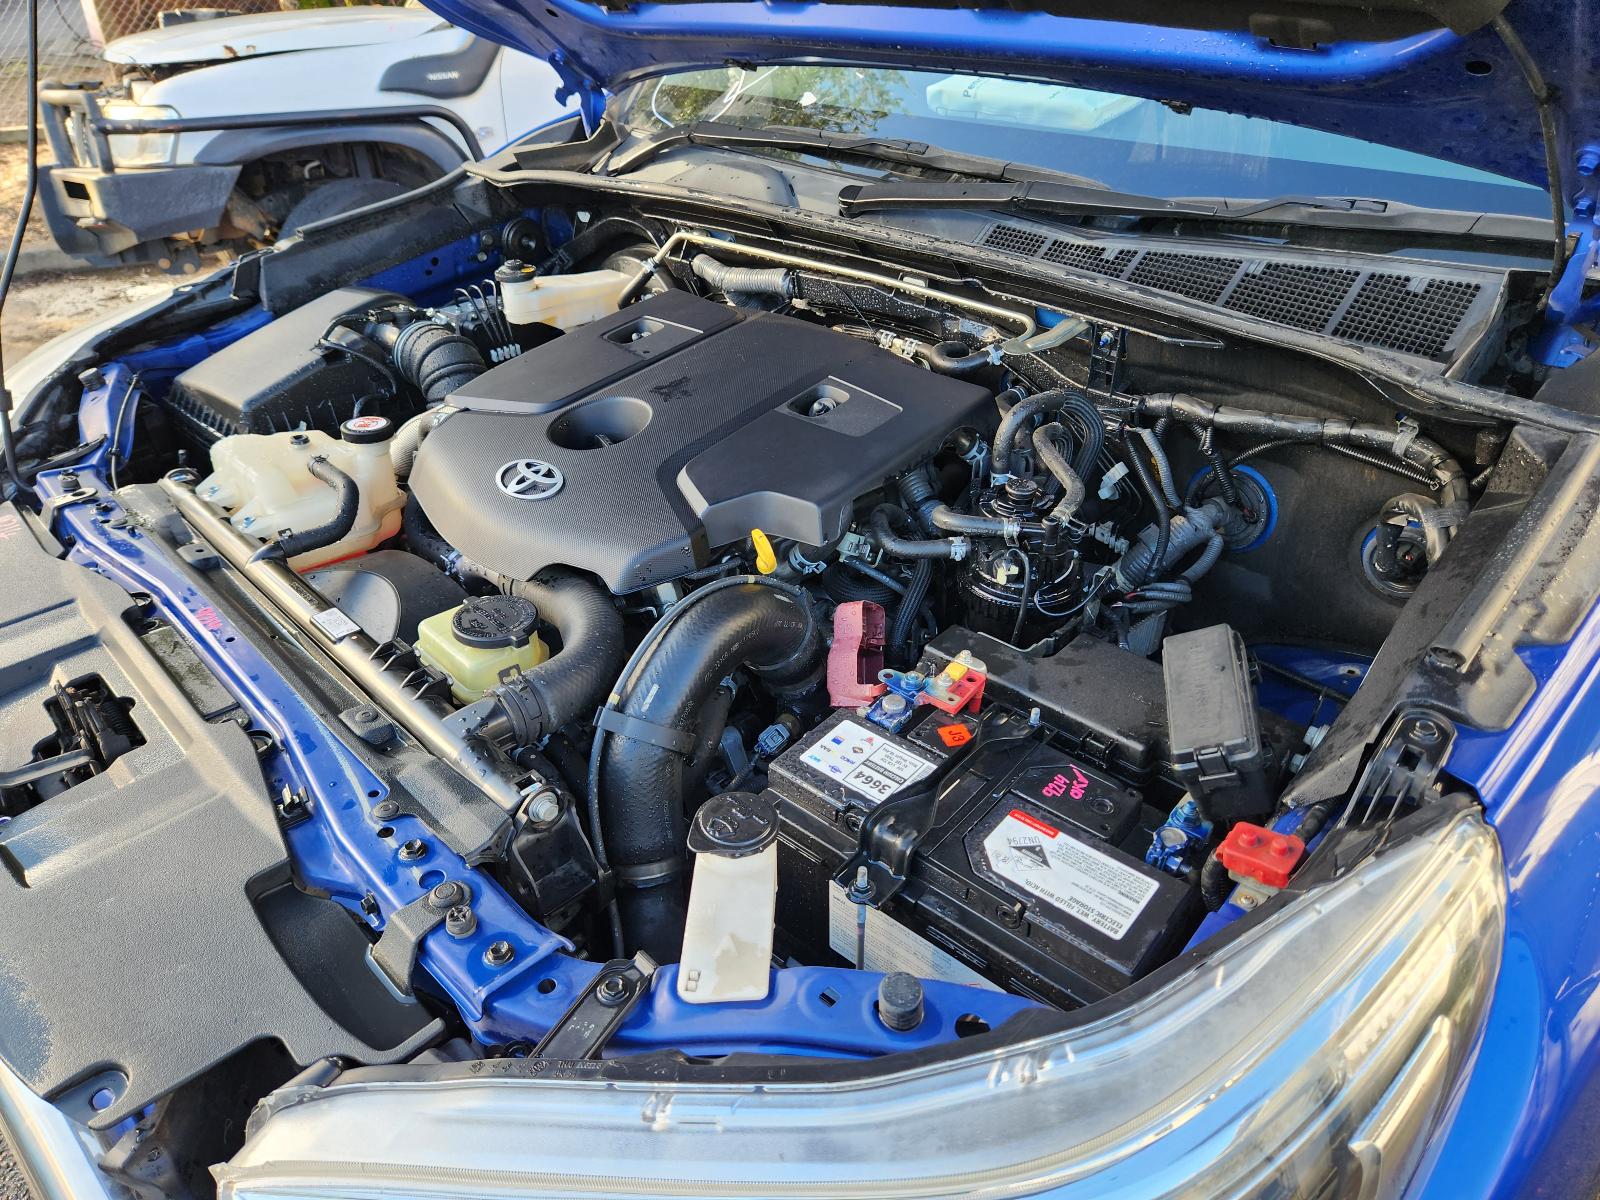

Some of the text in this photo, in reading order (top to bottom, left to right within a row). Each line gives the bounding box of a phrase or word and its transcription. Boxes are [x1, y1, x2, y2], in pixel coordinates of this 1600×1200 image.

[428, 71, 459, 80] NISSAN
[853, 770, 891, 795] 3664
[1042, 774, 1070, 797] 9214
[1007, 836, 1041, 846] UN2794
[1039, 887, 1055, 898] WITH
[1054, 895, 1075, 910] FILLED
[1067, 895, 1095, 913] STORAGE
[1094, 910, 1123, 929] ELECTRIC
